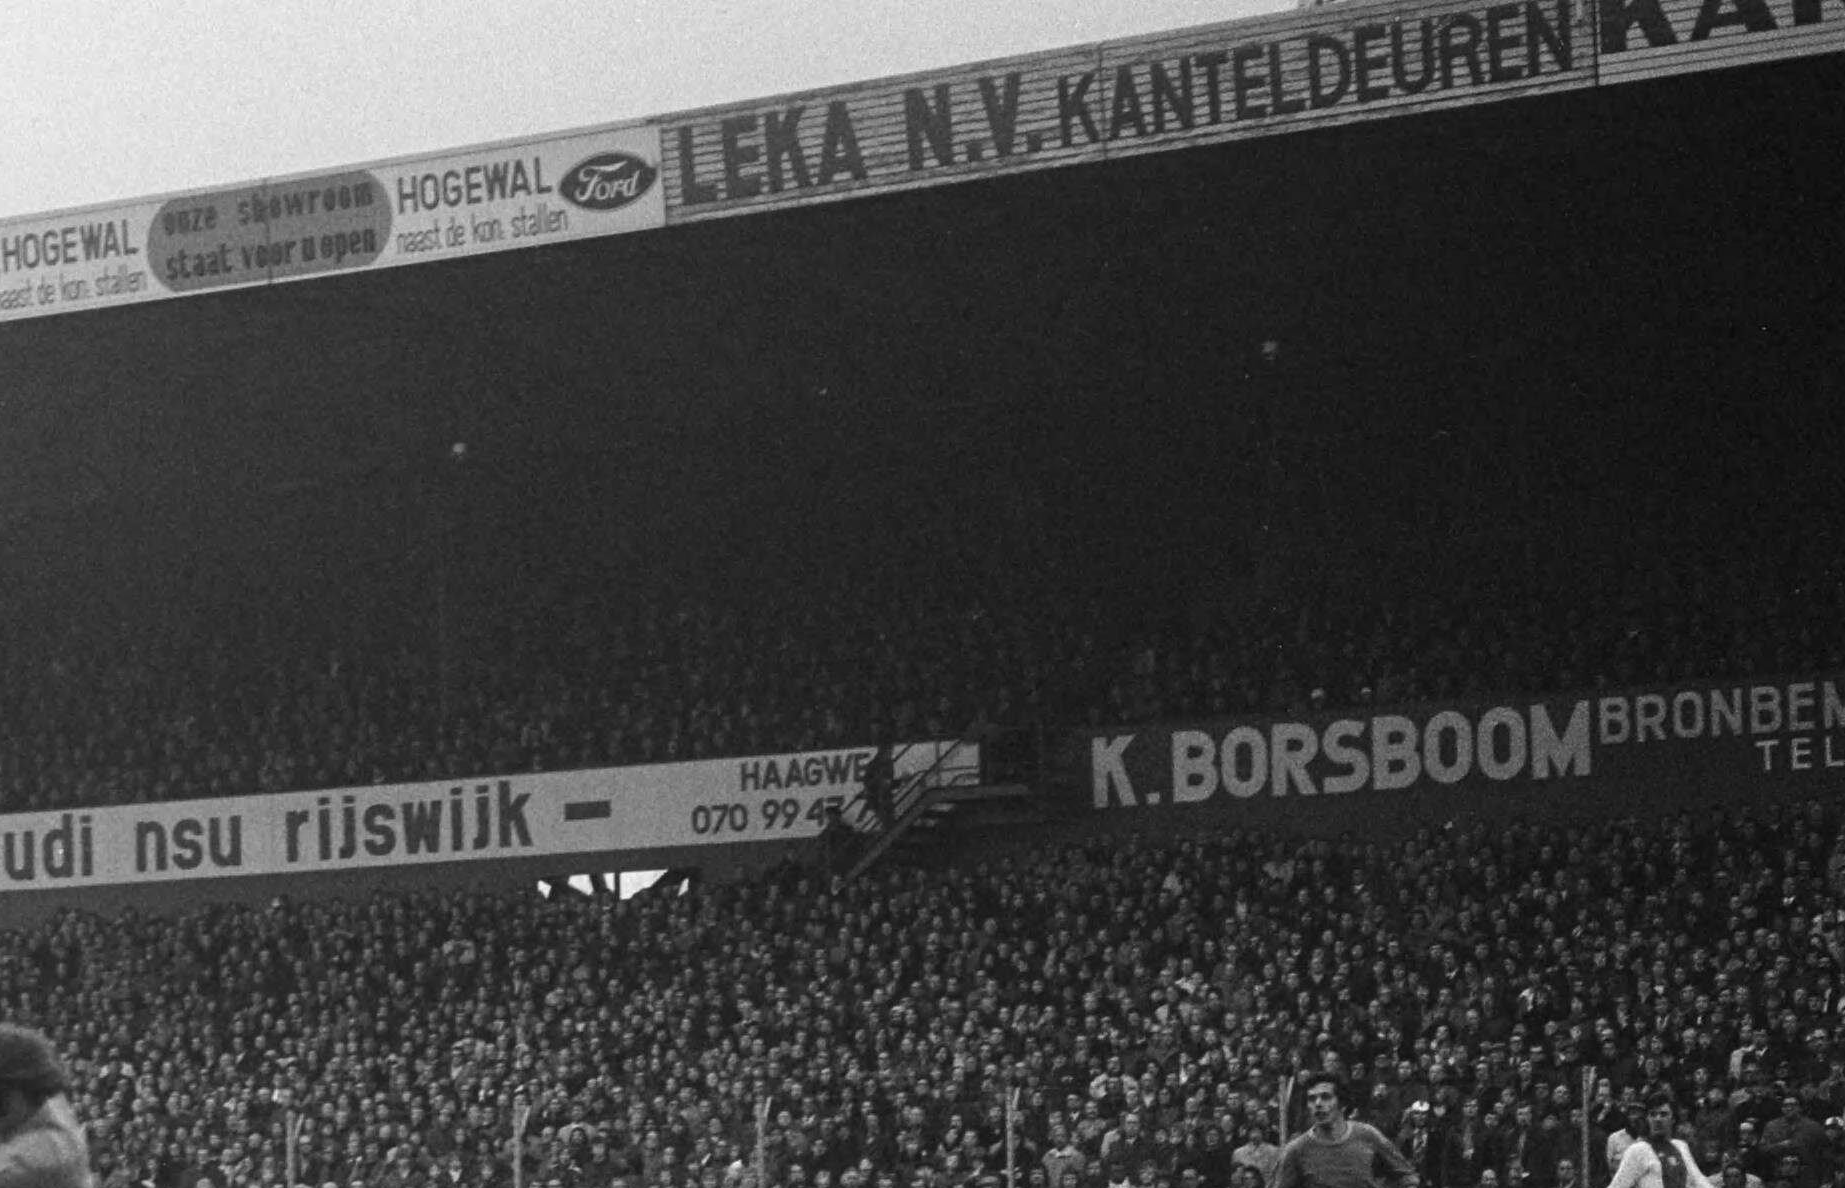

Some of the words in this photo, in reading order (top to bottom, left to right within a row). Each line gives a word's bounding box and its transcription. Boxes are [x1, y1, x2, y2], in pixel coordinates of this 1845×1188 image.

[679, 101, 867, 204] LEKA
[905, 72, 1043, 170] N.V.
[1057, 2, 1572, 148] KANTELDEUREN
[397, 157, 553, 214] HOGEWAL
[574, 160, 640, 202] Ford
[163, 206, 217, 235] onze
[238, 183, 372, 225] showroom
[396, 224, 440, 254] naast
[446, 216, 465, 246] de
[511, 202, 568, 239] stallen
[2, 219, 138, 271] HOGEWAL
[166, 244, 232, 280] staat
[242, 241, 296, 269] voor
[321, 229, 375, 264] open
[740, 753, 870, 791] HAAGWE
[1172, 701, 1591, 802] BORSBOOM
[135, 812, 242, 871] nsu
[284, 781, 532, 862] rijswijk
[692, 803, 748, 834] 070
